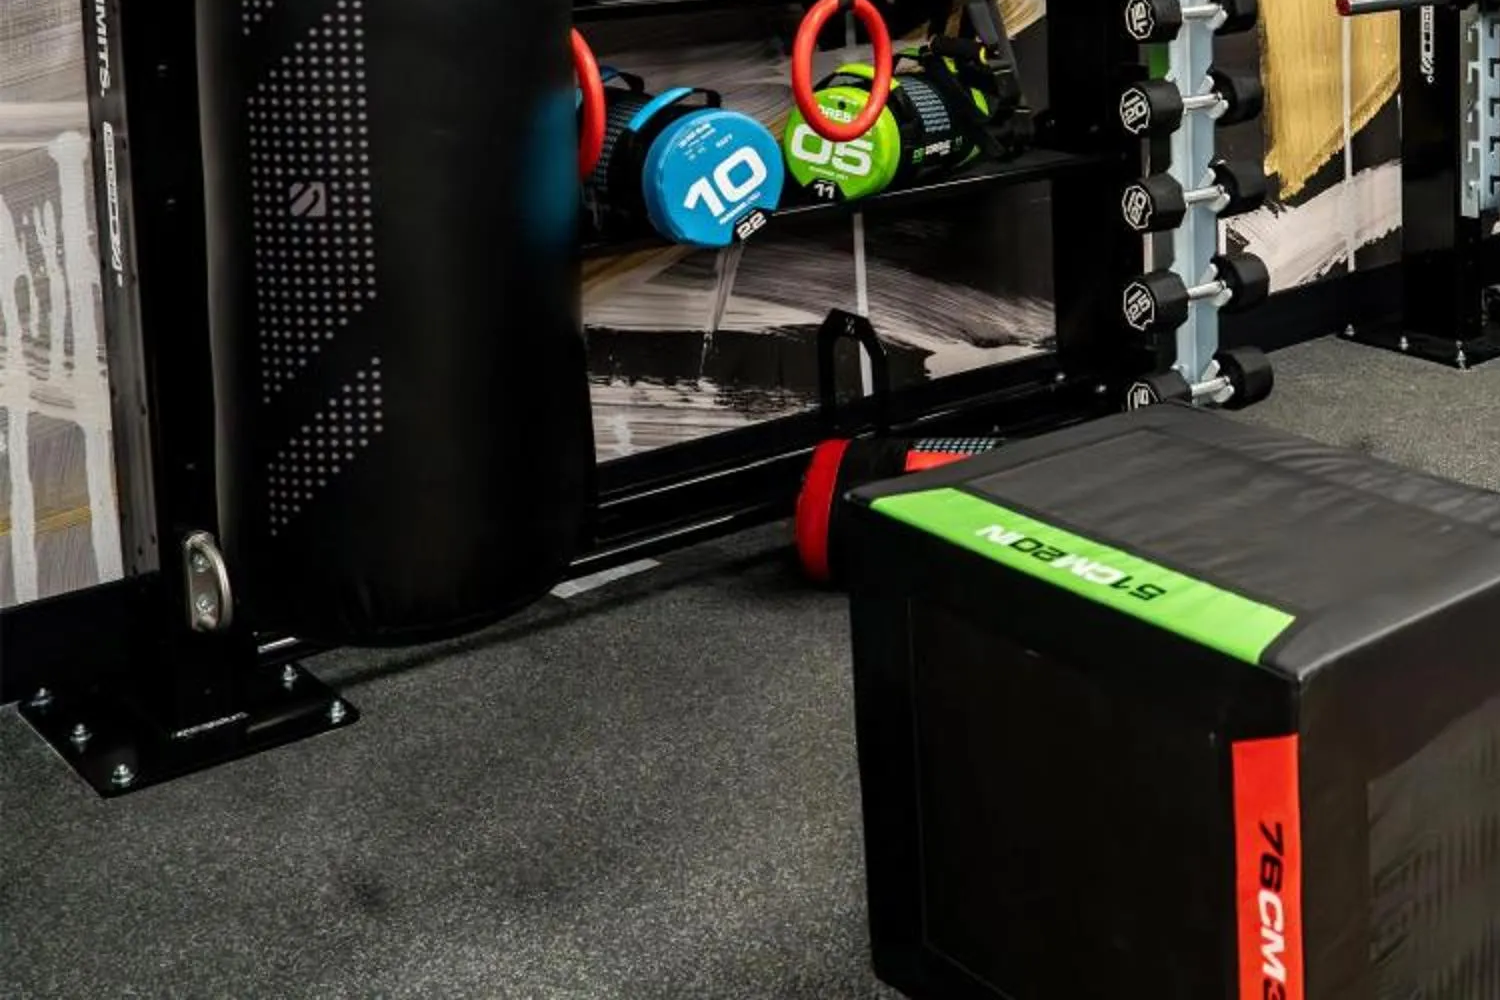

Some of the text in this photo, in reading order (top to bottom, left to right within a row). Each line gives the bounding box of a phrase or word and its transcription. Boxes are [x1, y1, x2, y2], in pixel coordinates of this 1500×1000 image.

[1124, 101, 1147, 124] 20
[791, 124, 874, 176] 05
[684, 146, 767, 216] 10
[814, 183, 835, 199] 11
[736, 211, 767, 240] 22
[1128, 293, 1151, 321] 25
